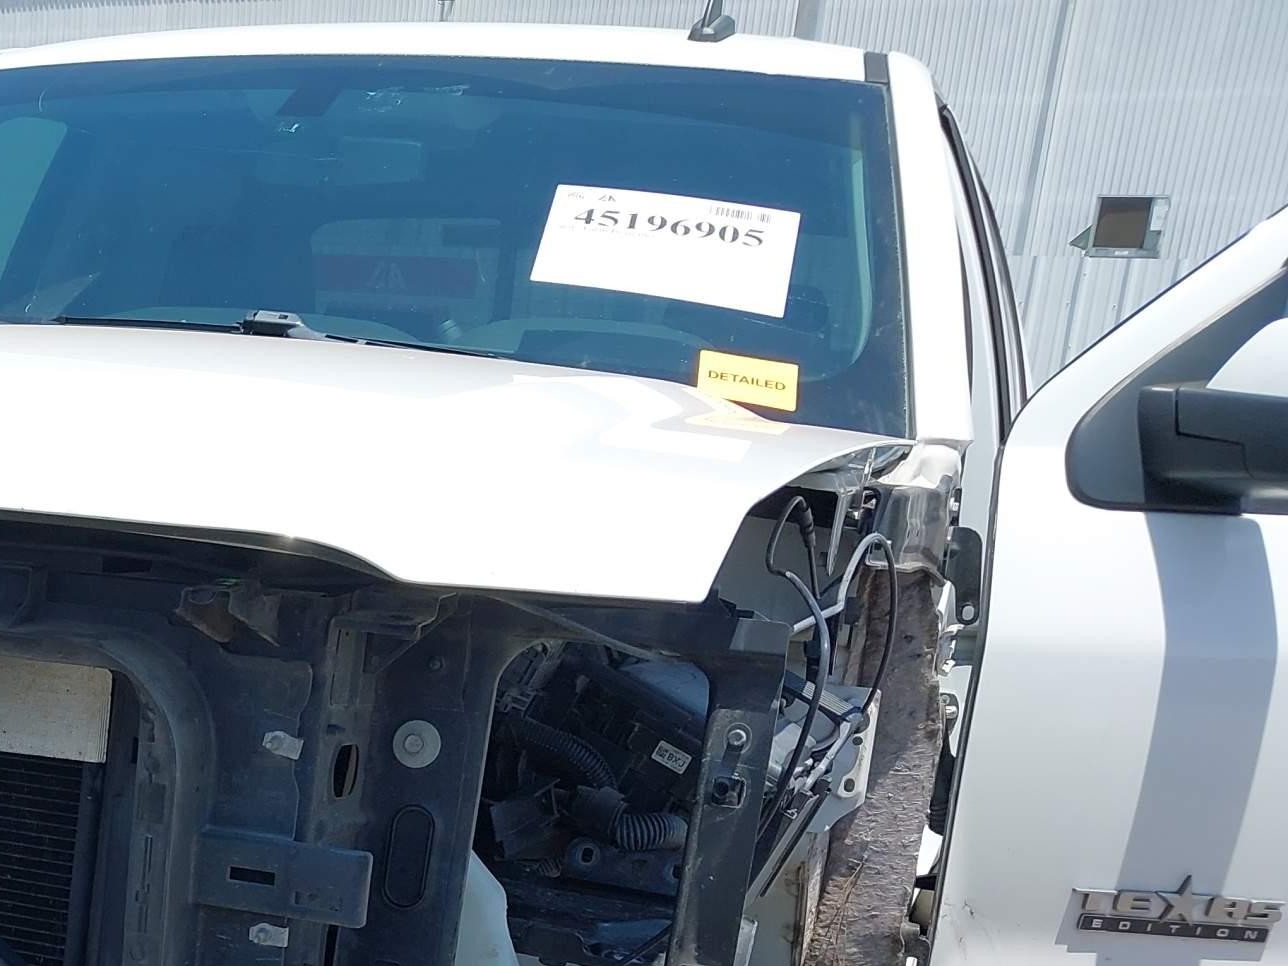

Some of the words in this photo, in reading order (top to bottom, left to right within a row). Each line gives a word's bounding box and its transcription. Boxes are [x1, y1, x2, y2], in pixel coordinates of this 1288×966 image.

[573, 208, 765, 247] 45196905
[707, 369, 787, 391] DETAILED
[1072, 875, 1286, 925] TEXAS
[1091, 917, 1259, 940] EDITION
